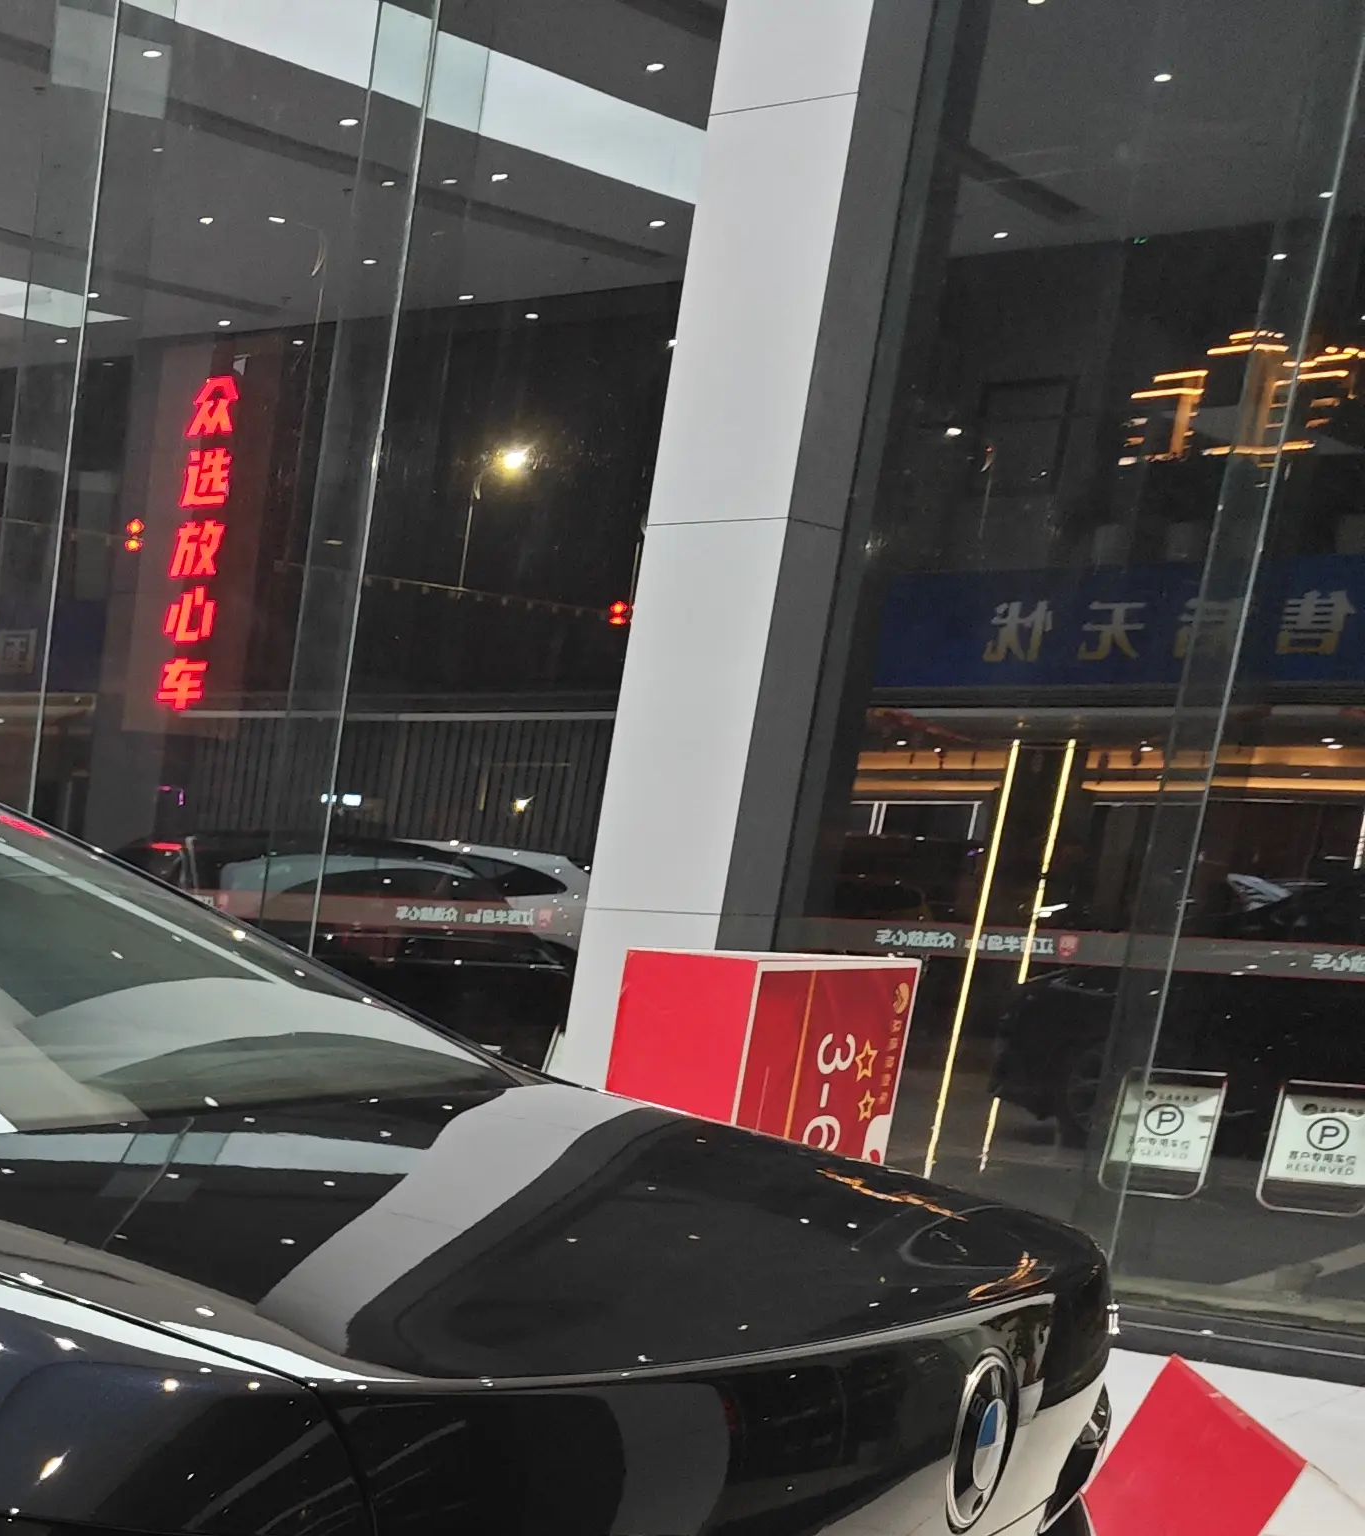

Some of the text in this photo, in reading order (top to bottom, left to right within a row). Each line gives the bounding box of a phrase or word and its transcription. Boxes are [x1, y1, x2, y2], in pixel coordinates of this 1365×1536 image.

[156, 374, 239, 711] 众选放心车
[1317, 1125, 1341, 1145] P
